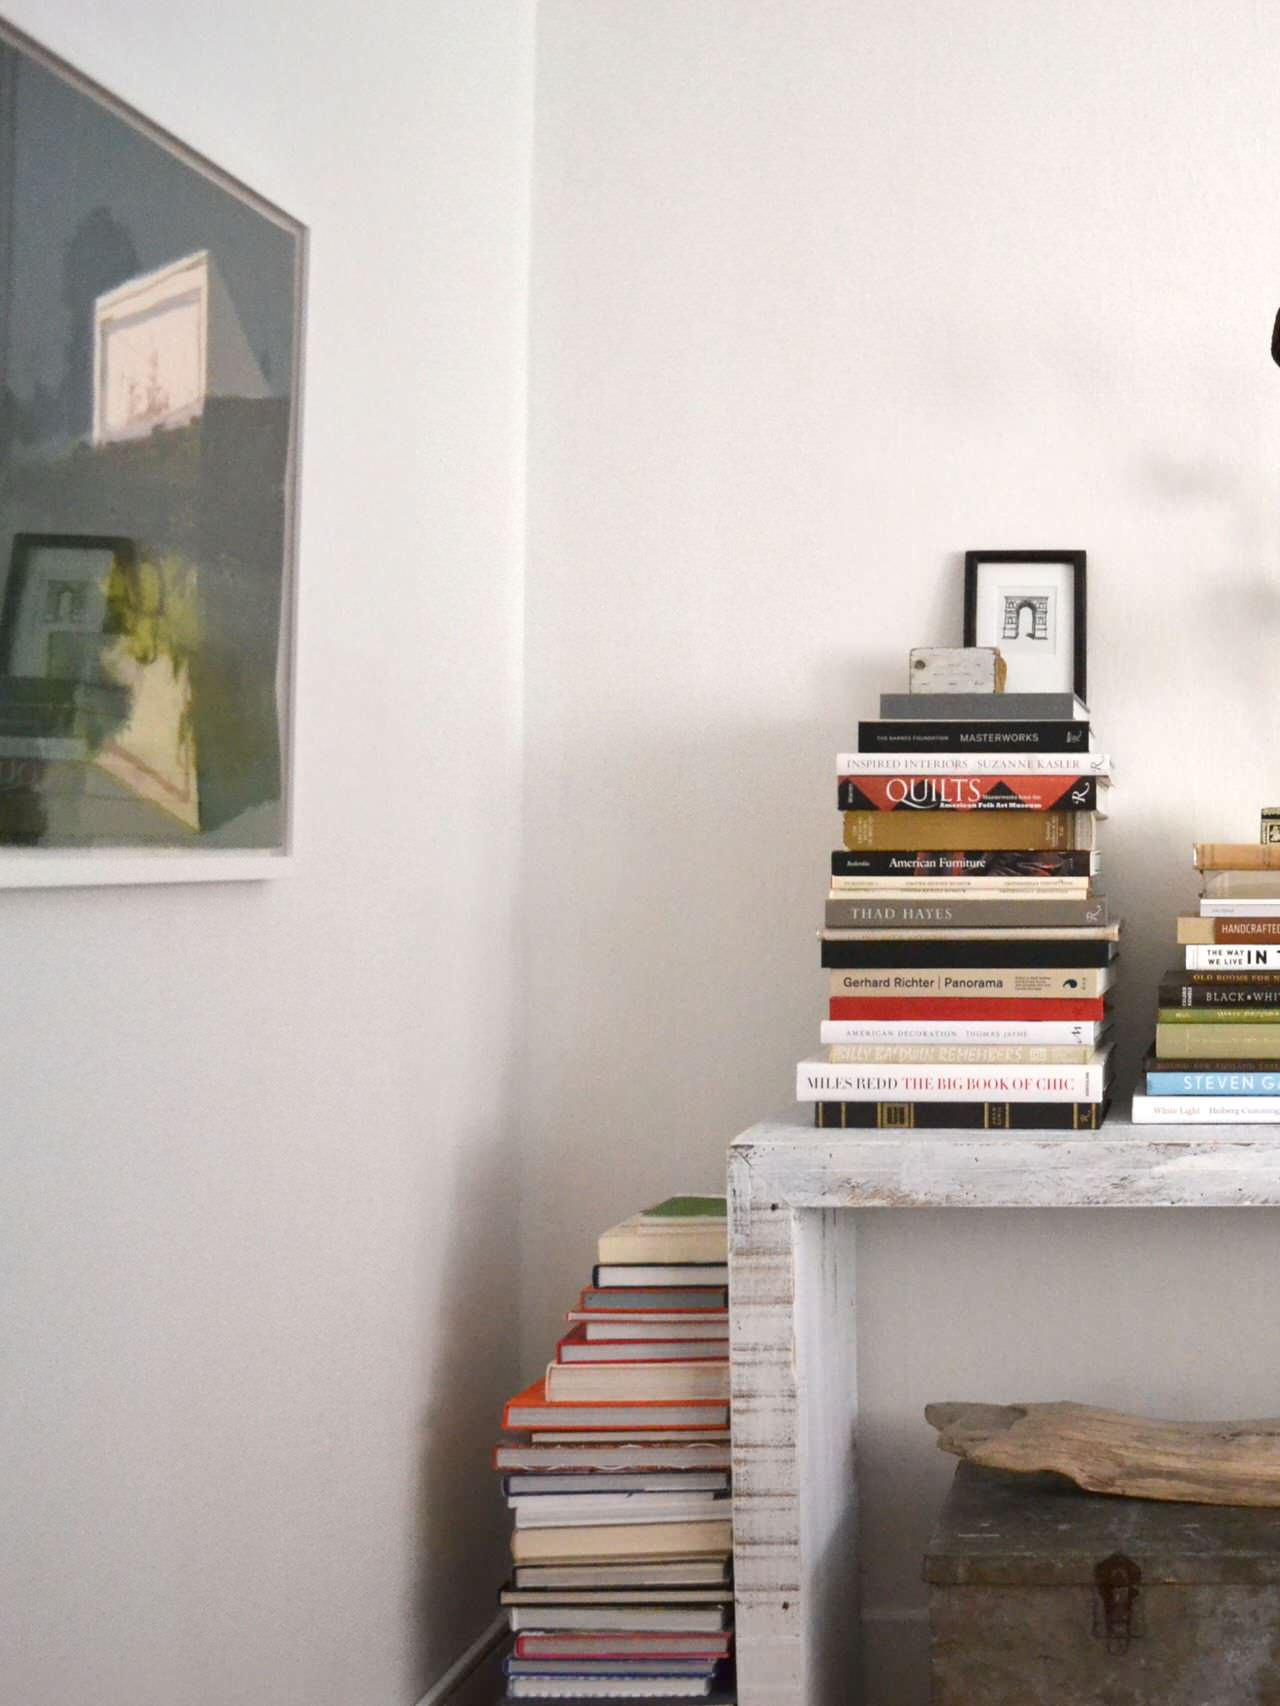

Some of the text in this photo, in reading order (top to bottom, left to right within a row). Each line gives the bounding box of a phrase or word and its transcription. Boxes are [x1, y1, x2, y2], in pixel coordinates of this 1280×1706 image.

[960, 733, 1039, 743] MASTERWORKS
[847, 758, 1080, 769] INSPIRED INTERIORS SUZANNE KASLER
[886, 778, 981, 809] QUILTS
[889, 857, 986, 869] American Furniture
[851, 908, 953, 920] THAD HAYES
[1247, 950, 1268, 965] IN
[843, 977, 891, 989] Gerhard
[893, 977, 934, 989] Richter
[944, 977, 1004, 988] Panorama
[1206, 992, 1245, 1001] BLACK
[807, 1076, 853, 1090] MILES
[856, 1076, 898, 1090] REDD
[901, 1076, 937, 1090] THE
[937, 1076, 964, 1090] BIG
[967, 1076, 1009, 1090] BOOK
[1012, 1076, 1035, 1090] OF
[1036, 1076, 1075, 1090] CHIC
[1183, 1076, 1255, 1090] STEVEN
[1153, 1106, 1177, 1115] White
[1179, 1106, 1201, 1117] Light
